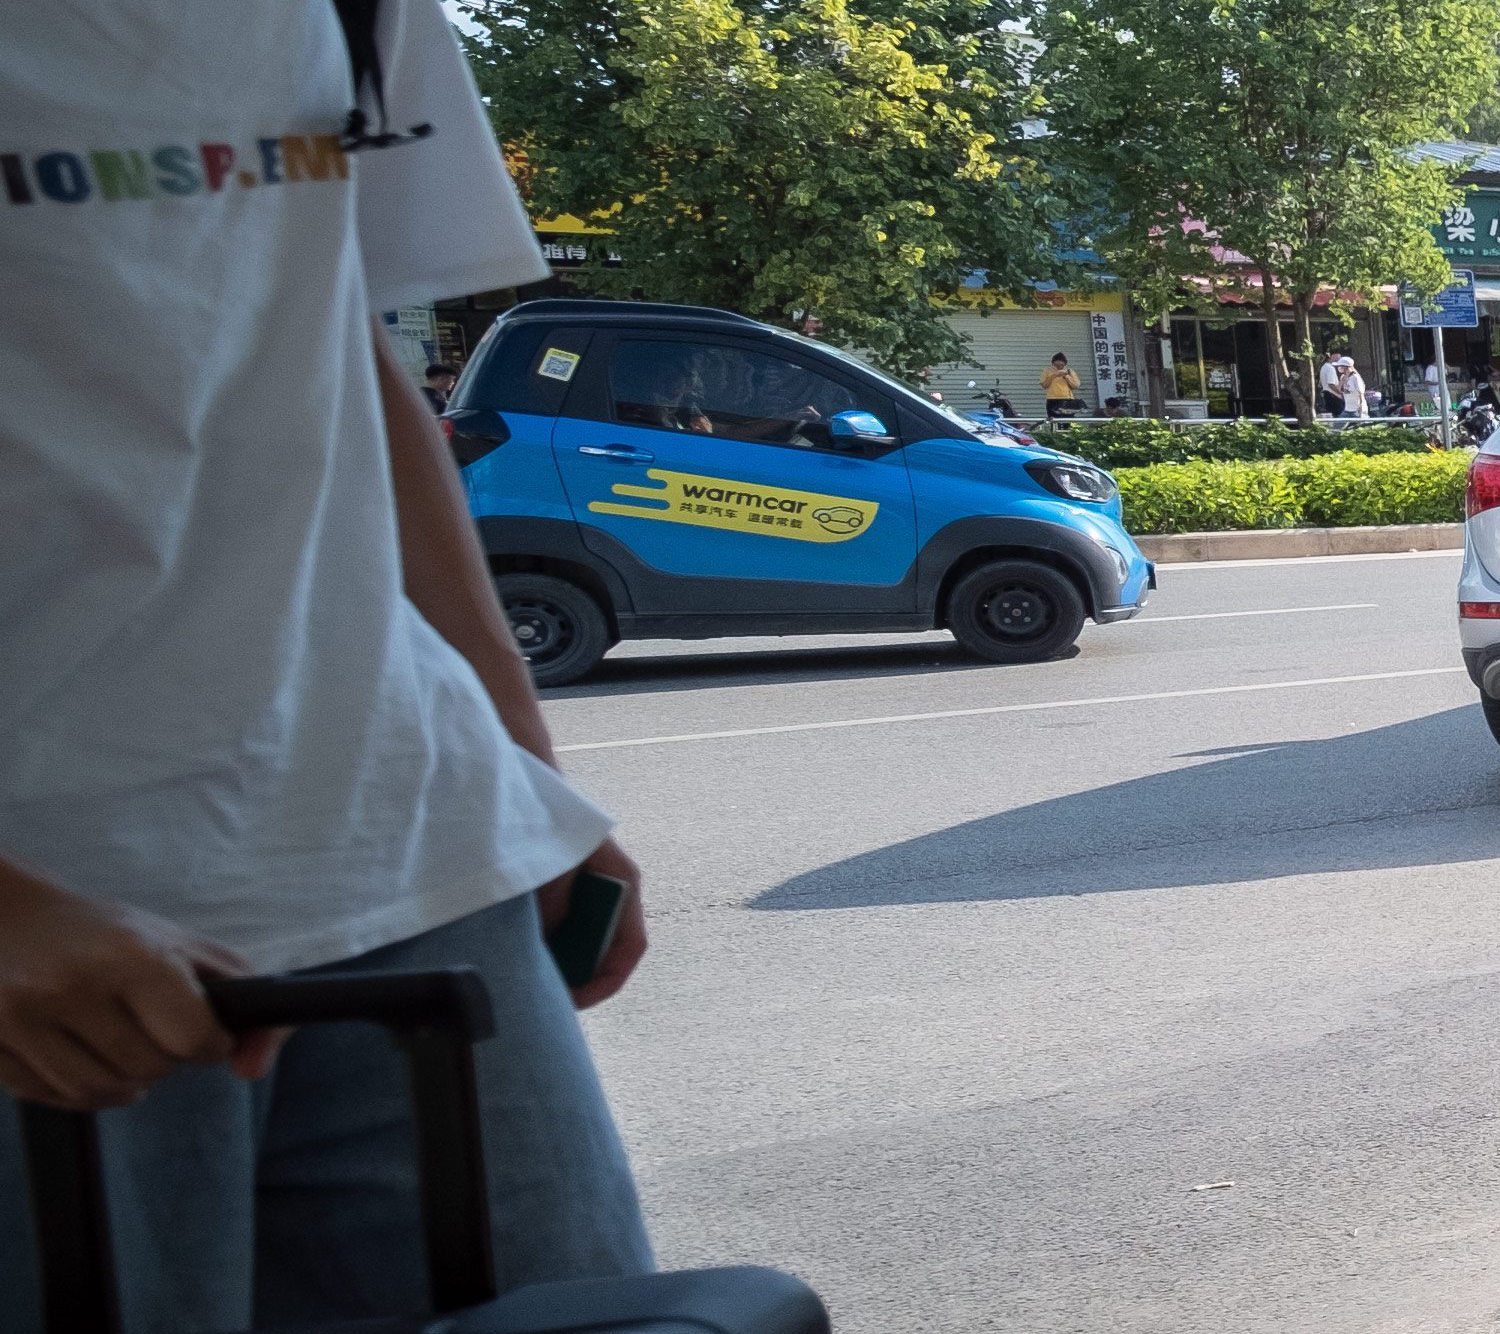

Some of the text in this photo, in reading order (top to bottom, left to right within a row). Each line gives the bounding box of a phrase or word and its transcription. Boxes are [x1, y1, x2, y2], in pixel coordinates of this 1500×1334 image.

[679, 501, 739, 520] 共享汽车
[682, 483, 809, 515] warmcar
